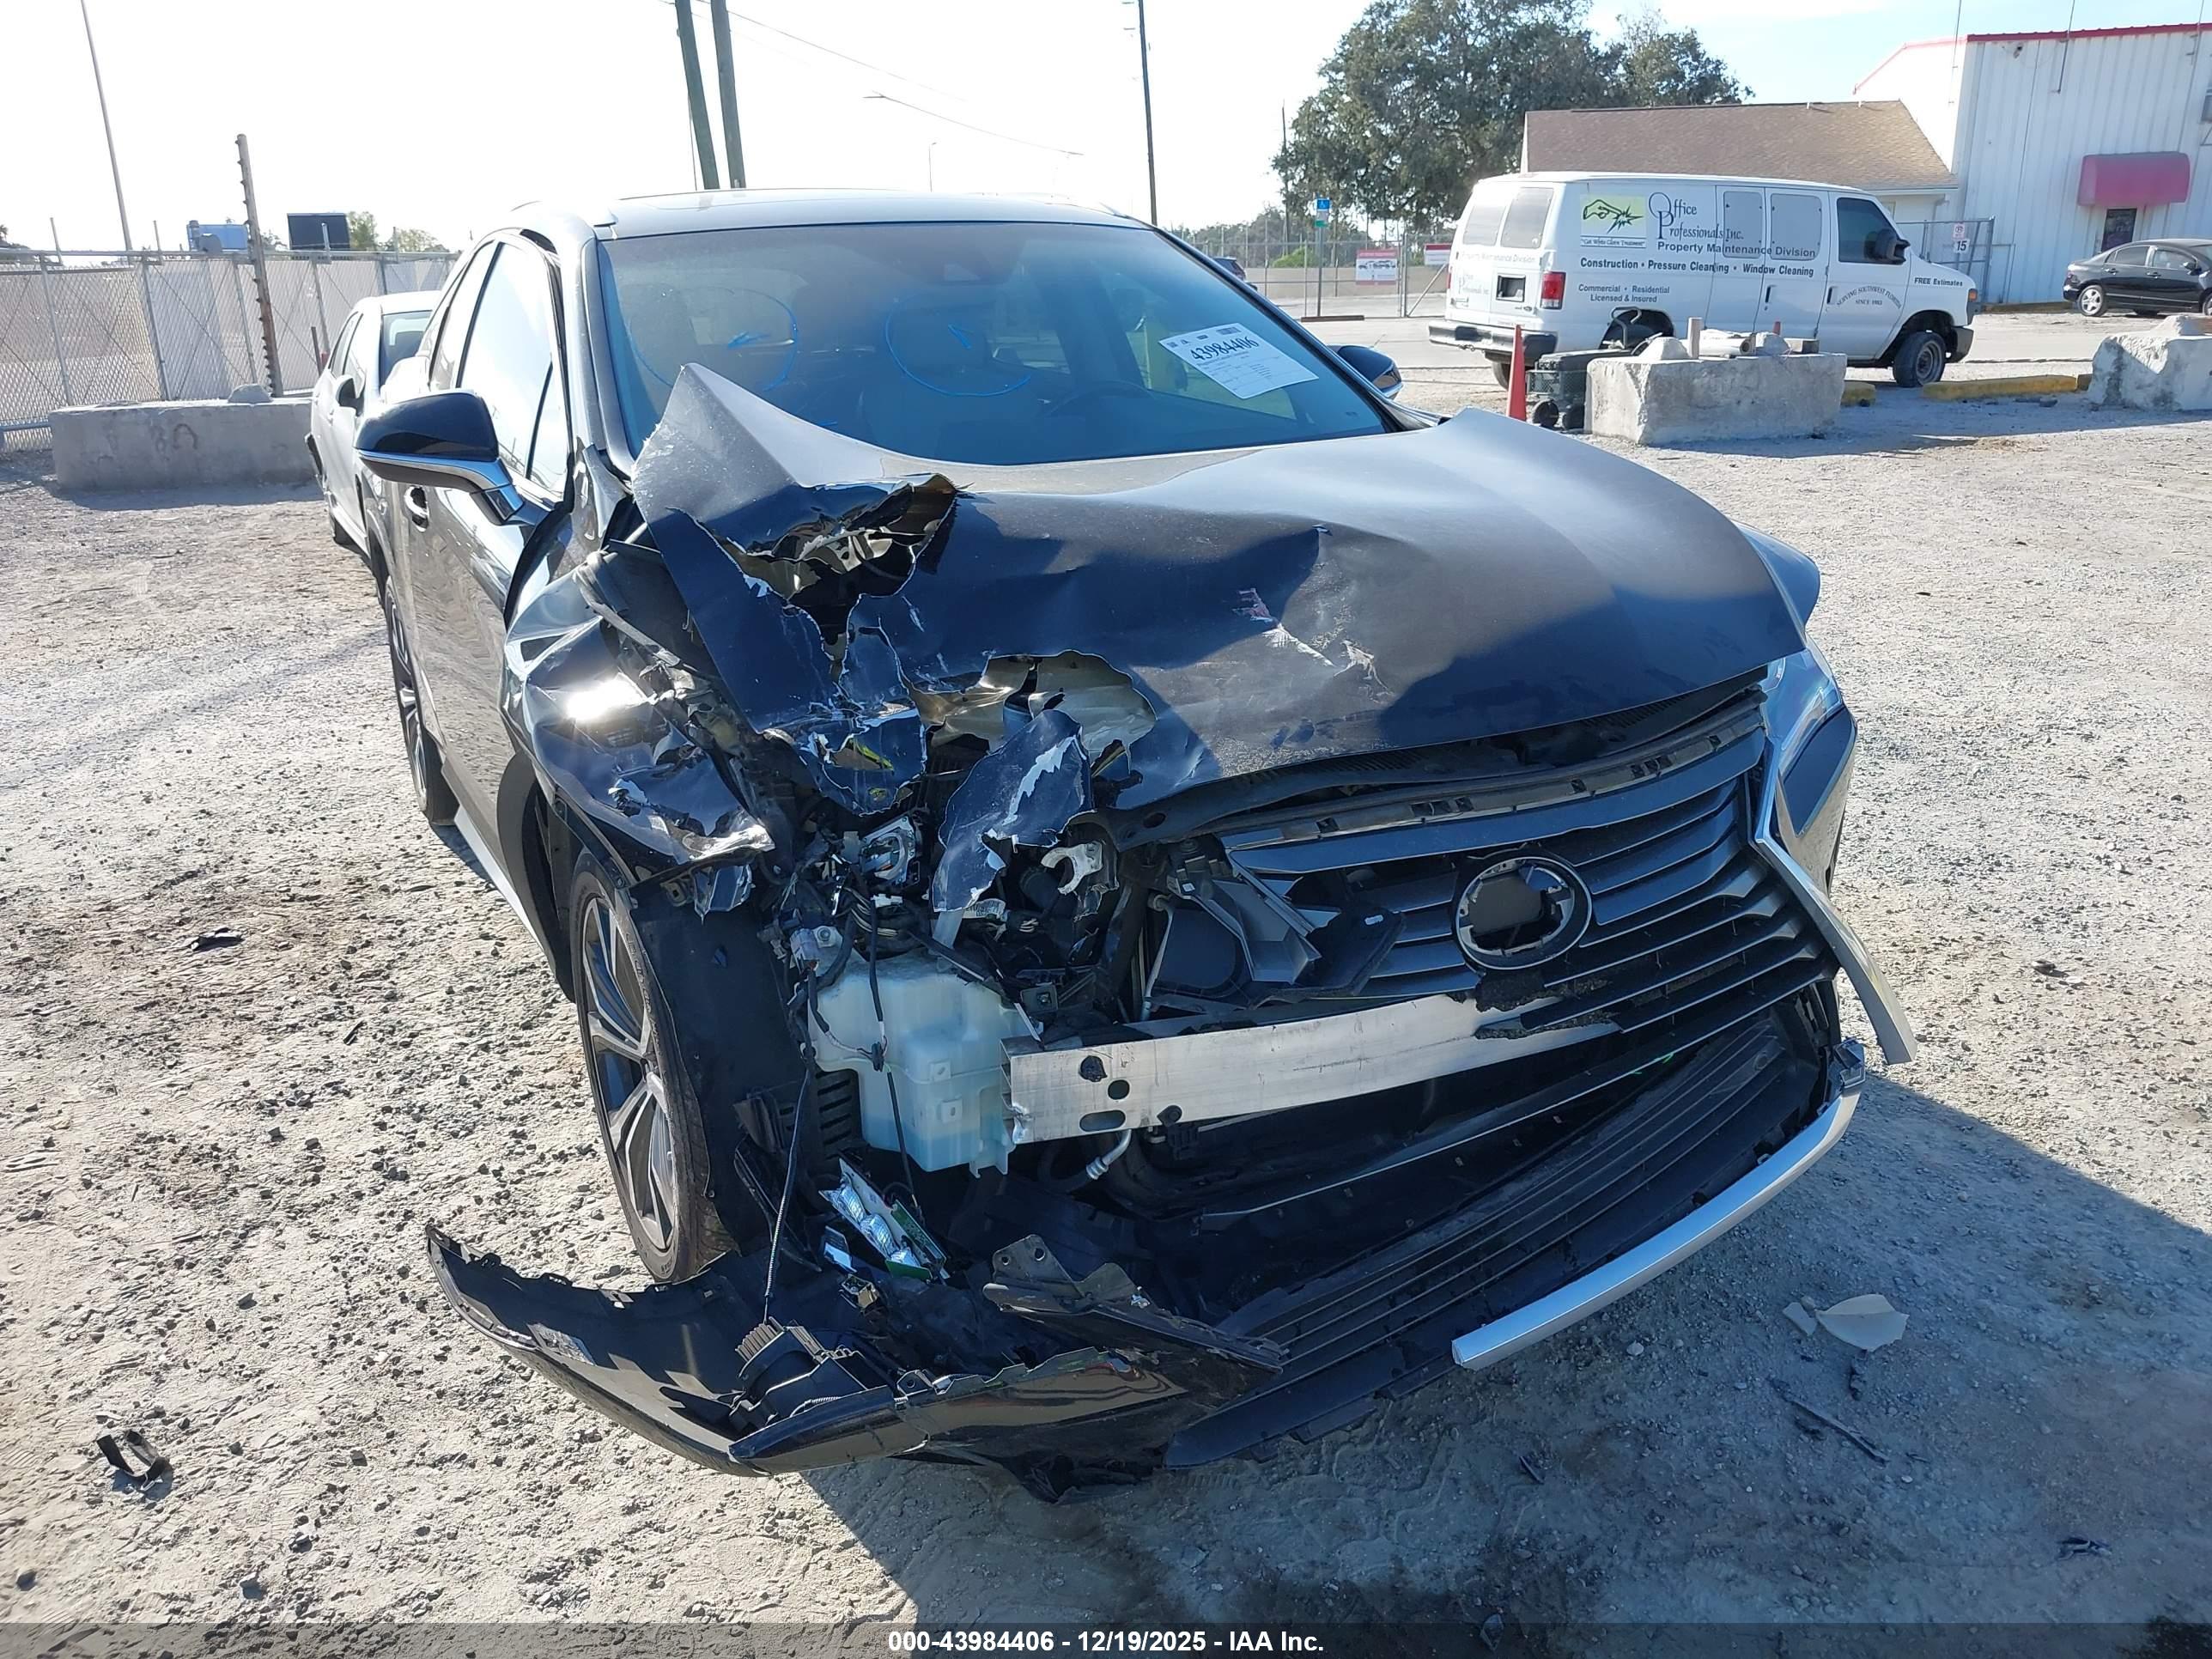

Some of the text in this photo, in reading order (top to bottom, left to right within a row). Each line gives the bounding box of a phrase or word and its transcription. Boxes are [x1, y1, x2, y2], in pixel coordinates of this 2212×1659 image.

[1649, 191, 1698, 219] Office
[1656, 210, 1744, 240] Professionals Inc.
[1657, 241, 1815, 257] Property Maintenance Division
[1957, 240, 1967, 252] 15
[1580, 258, 1814, 277] Construction Pressure Cleaning Window Cleaning
[1578, 283, 1670, 294] Commercial Residential
[1590, 294, 1623, 302] Licensed
[1190, 336, 1259, 361] 43984406
